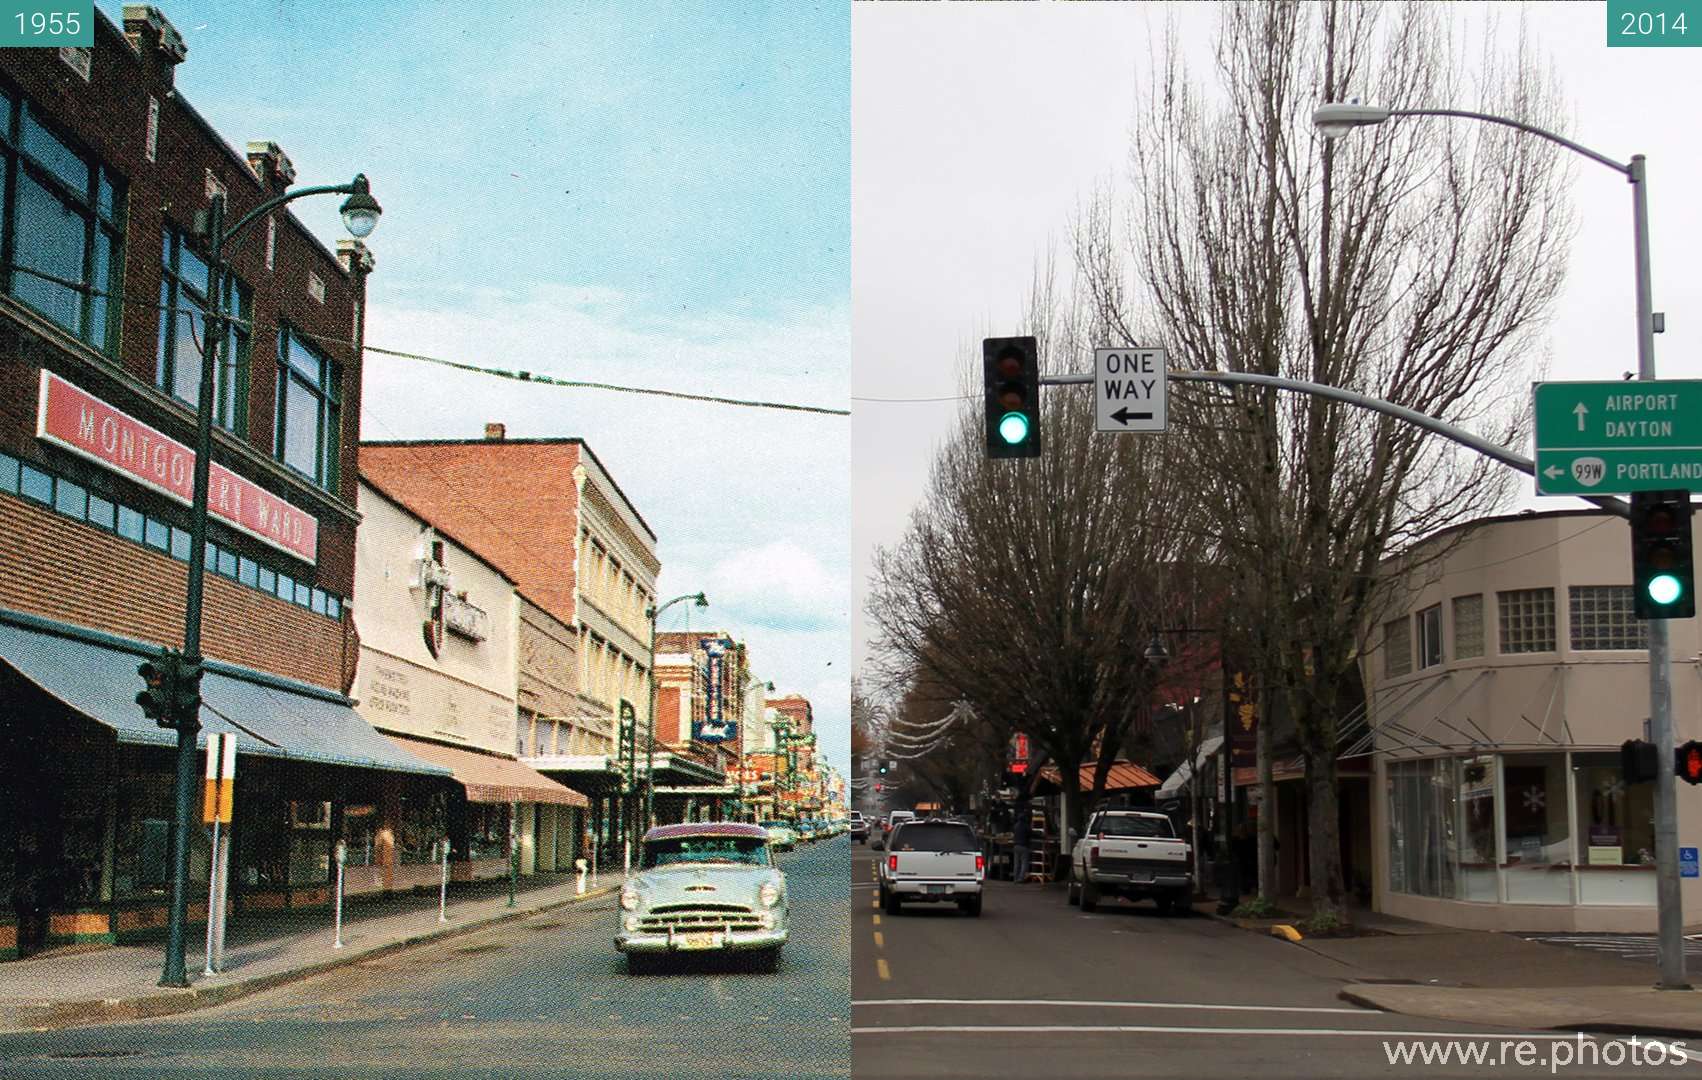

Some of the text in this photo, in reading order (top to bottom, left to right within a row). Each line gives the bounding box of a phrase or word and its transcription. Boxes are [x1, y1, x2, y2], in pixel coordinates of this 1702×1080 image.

[1106, 353, 1154, 374] ONE
[1104, 379, 1156, 400] WAY
[1605, 394, 1678, 411] AIRPORT
[1605, 421, 1672, 437] DAYTON
[1575, 464, 1602, 480] 99W
[1616, 463, 1702, 479] PORTLAND
